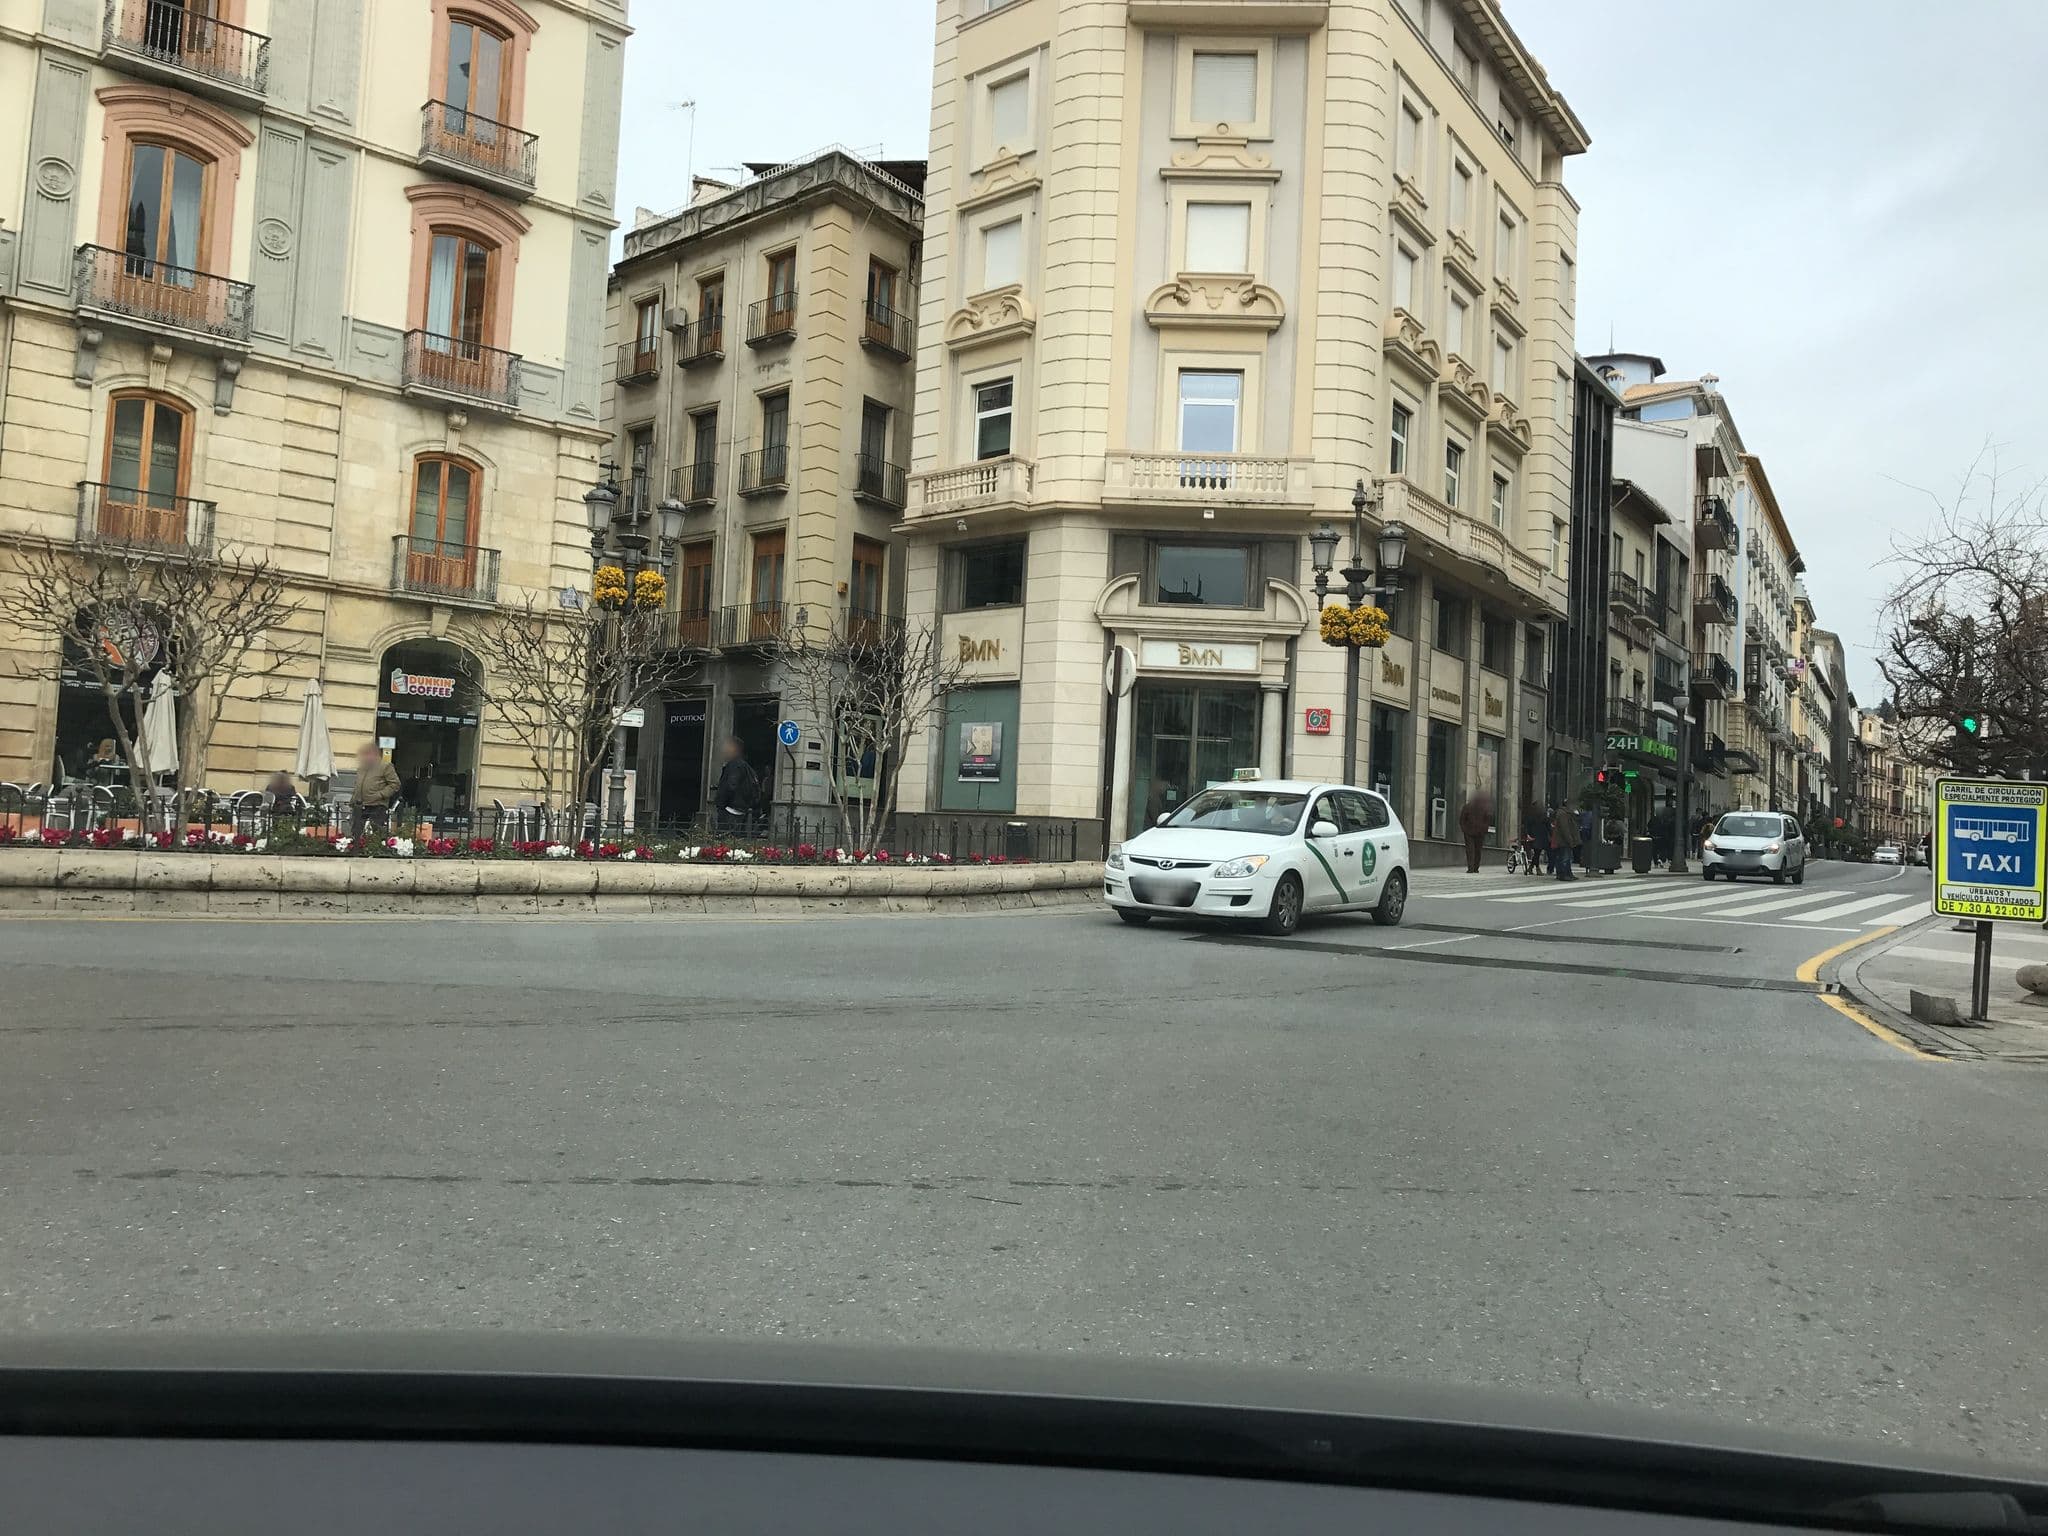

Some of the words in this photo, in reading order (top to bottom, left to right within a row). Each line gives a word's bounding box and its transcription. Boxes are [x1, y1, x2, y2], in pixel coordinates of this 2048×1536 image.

[959, 634, 1000, 662] BMN
[1178, 643, 1223, 666] BMN
[409, 685, 452, 697] COFFEE
[670, 713, 706, 724] promod
[1607, 737, 1639, 750] 24H
[1945, 785, 1973, 794] CARRIL
[1944, 793, 1999, 802] ESPECIALMENTE
[2001, 795, 2041, 804] PROTEGIDO
[1962, 852, 2020, 873] TAXI
[1969, 888, 2005, 897] URBANOS
[1986, 896, 2034, 906] AUTORIZADOS
[1941, 901, 1955, 911] DE
[1959, 902, 1981, 913] 7:30
[1985, 905, 1992, 914] A
[1995, 905, 2025, 916] 22:00
